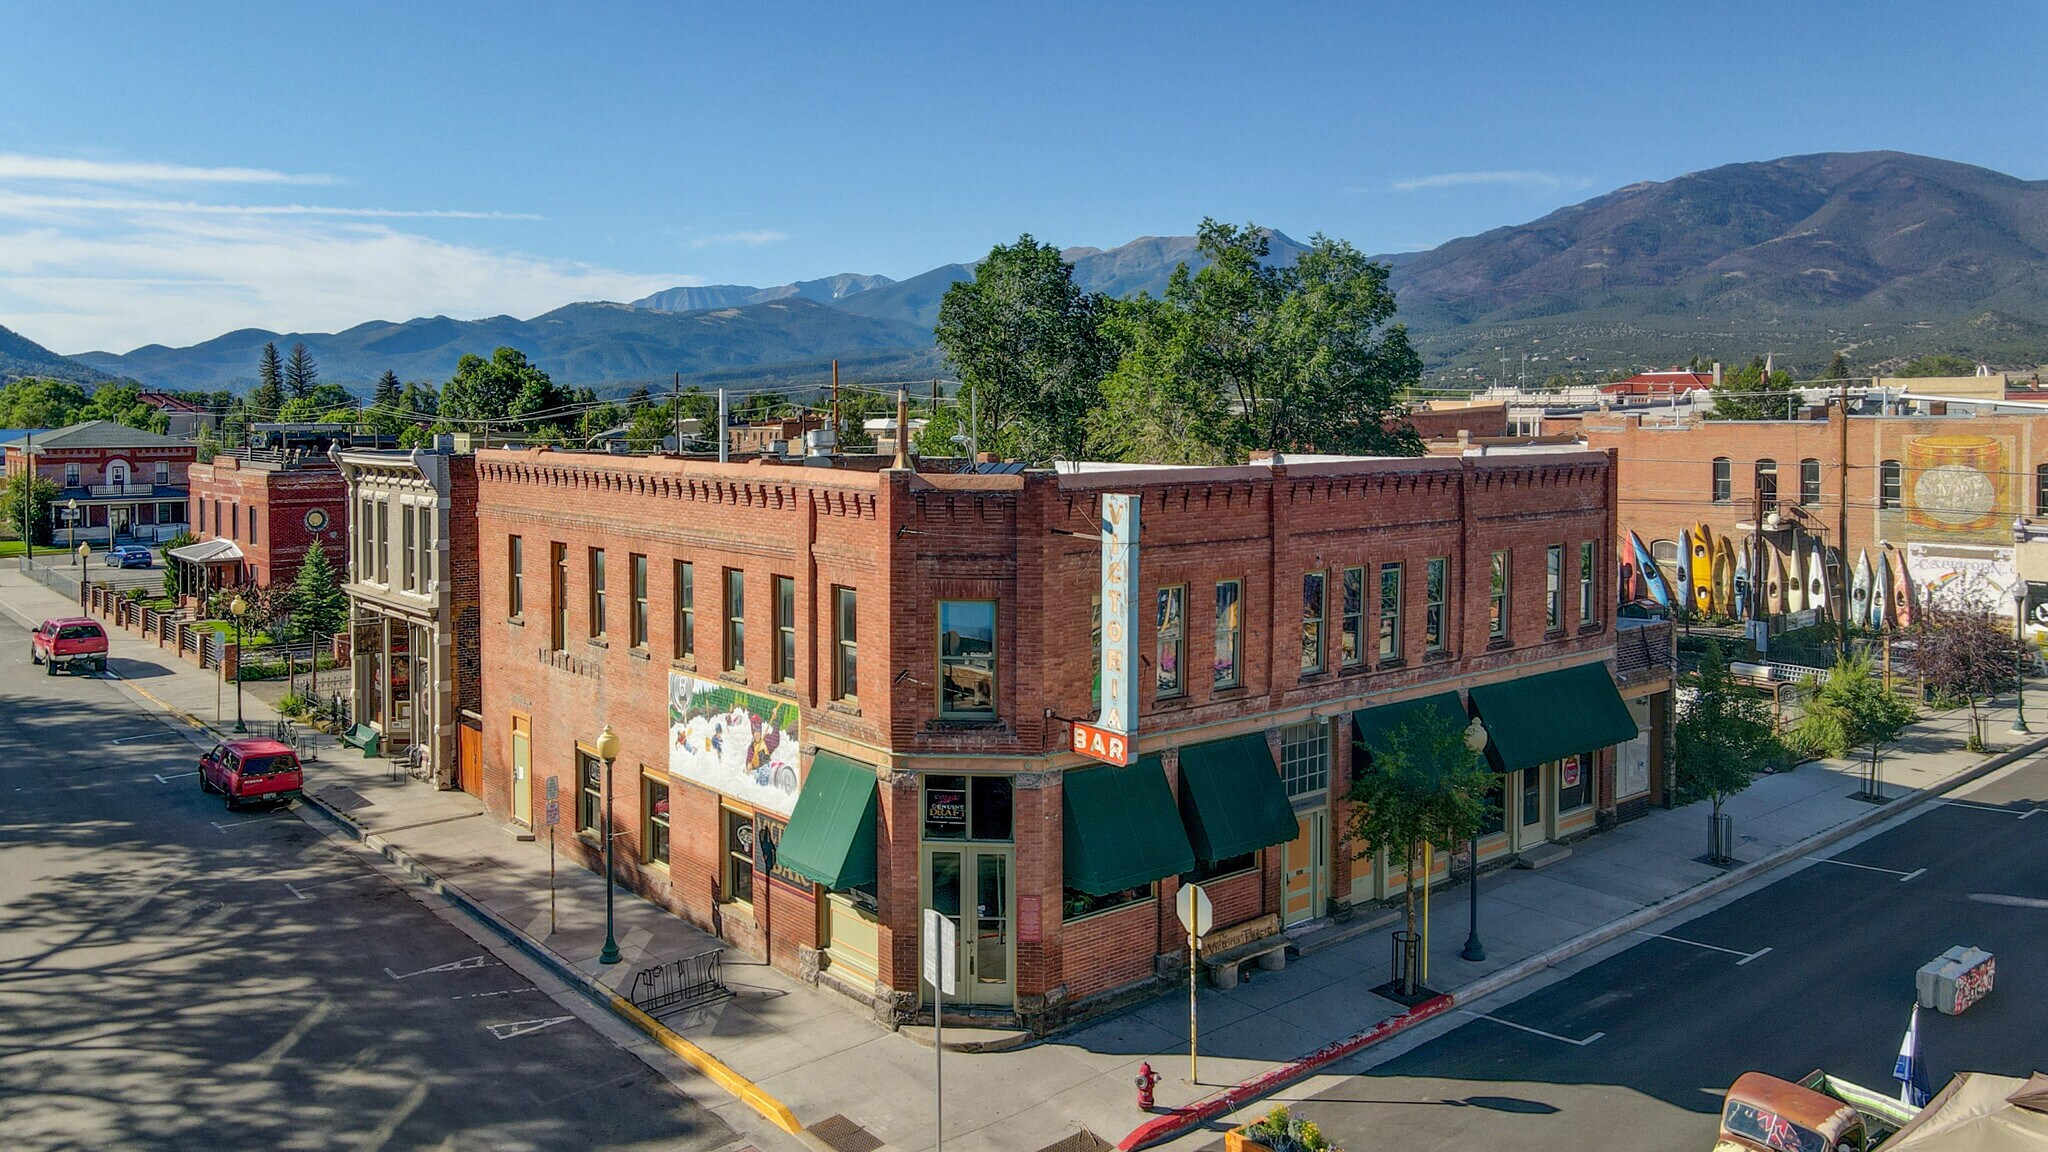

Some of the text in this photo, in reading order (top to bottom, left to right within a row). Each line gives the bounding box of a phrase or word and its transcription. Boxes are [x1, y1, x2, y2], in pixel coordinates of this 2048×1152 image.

[1108, 503, 1123, 730] VICTORIA
[1074, 727, 1124, 761] BAR
[929, 808, 965, 817] DRAFT
[1207, 935, 1241, 955] Victoria
